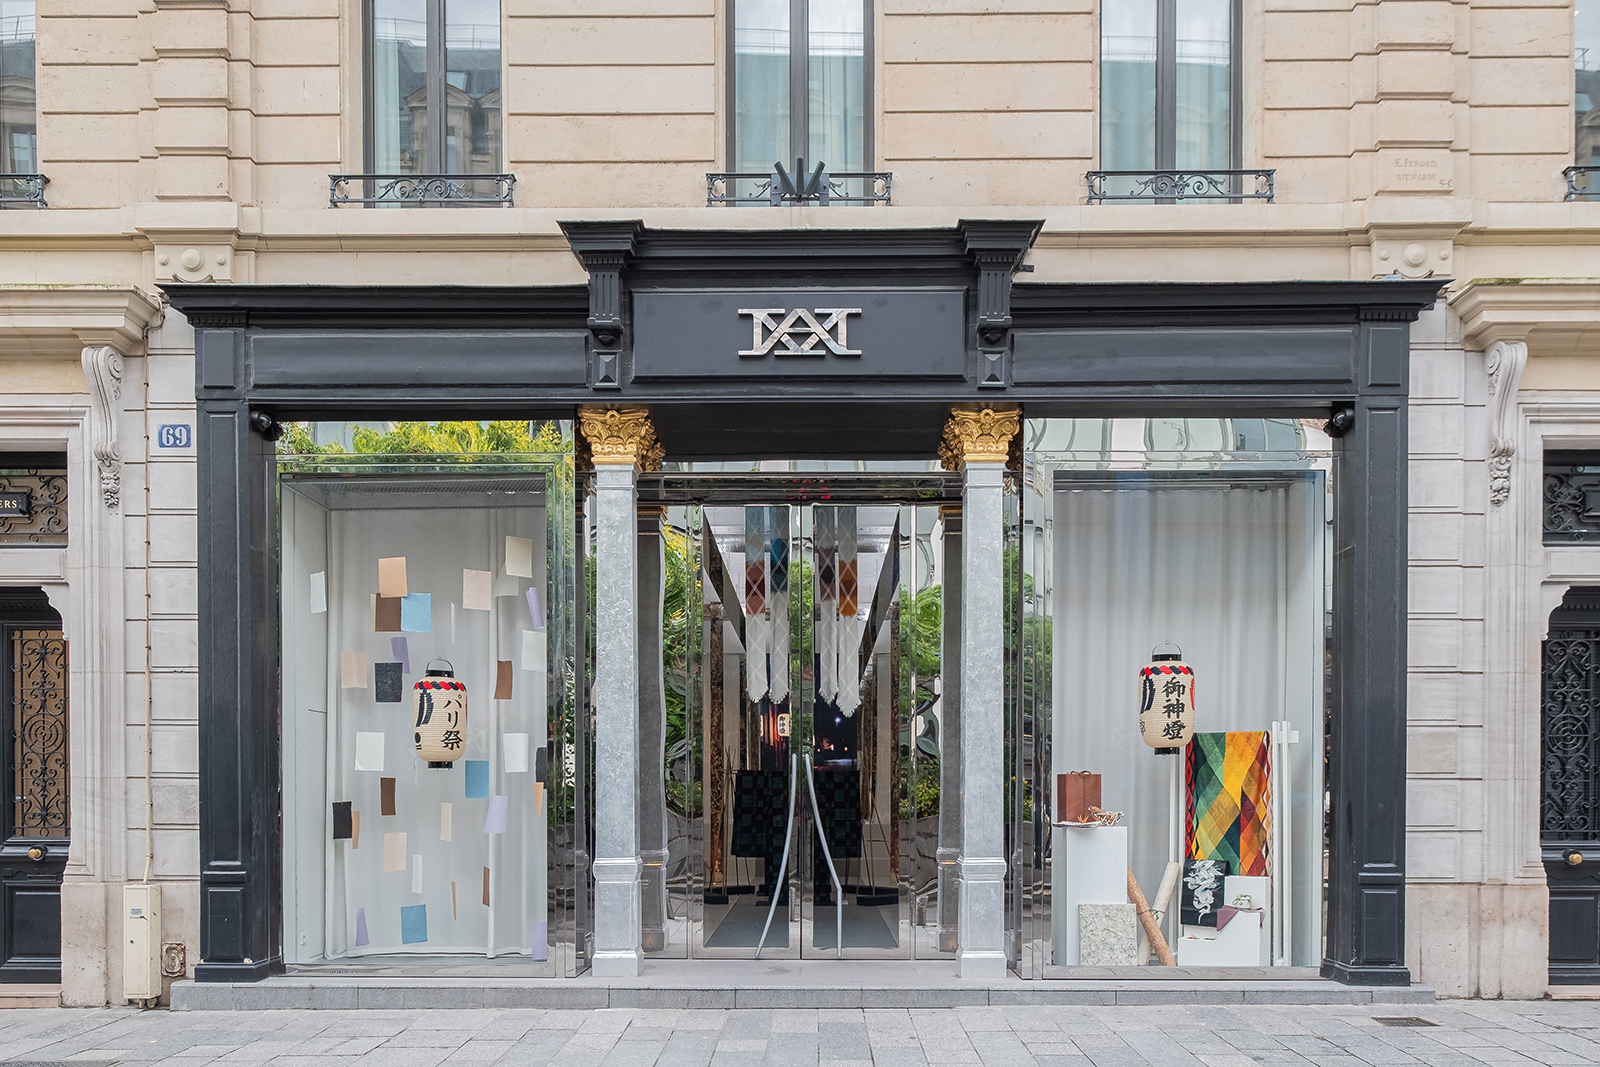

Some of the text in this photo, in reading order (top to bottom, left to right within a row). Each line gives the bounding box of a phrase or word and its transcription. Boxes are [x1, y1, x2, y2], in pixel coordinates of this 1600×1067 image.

[161, 426, 187, 447] 69
[440, 693, 464, 751] パリ祭
[1161, 676, 1187, 740] 御神燈
